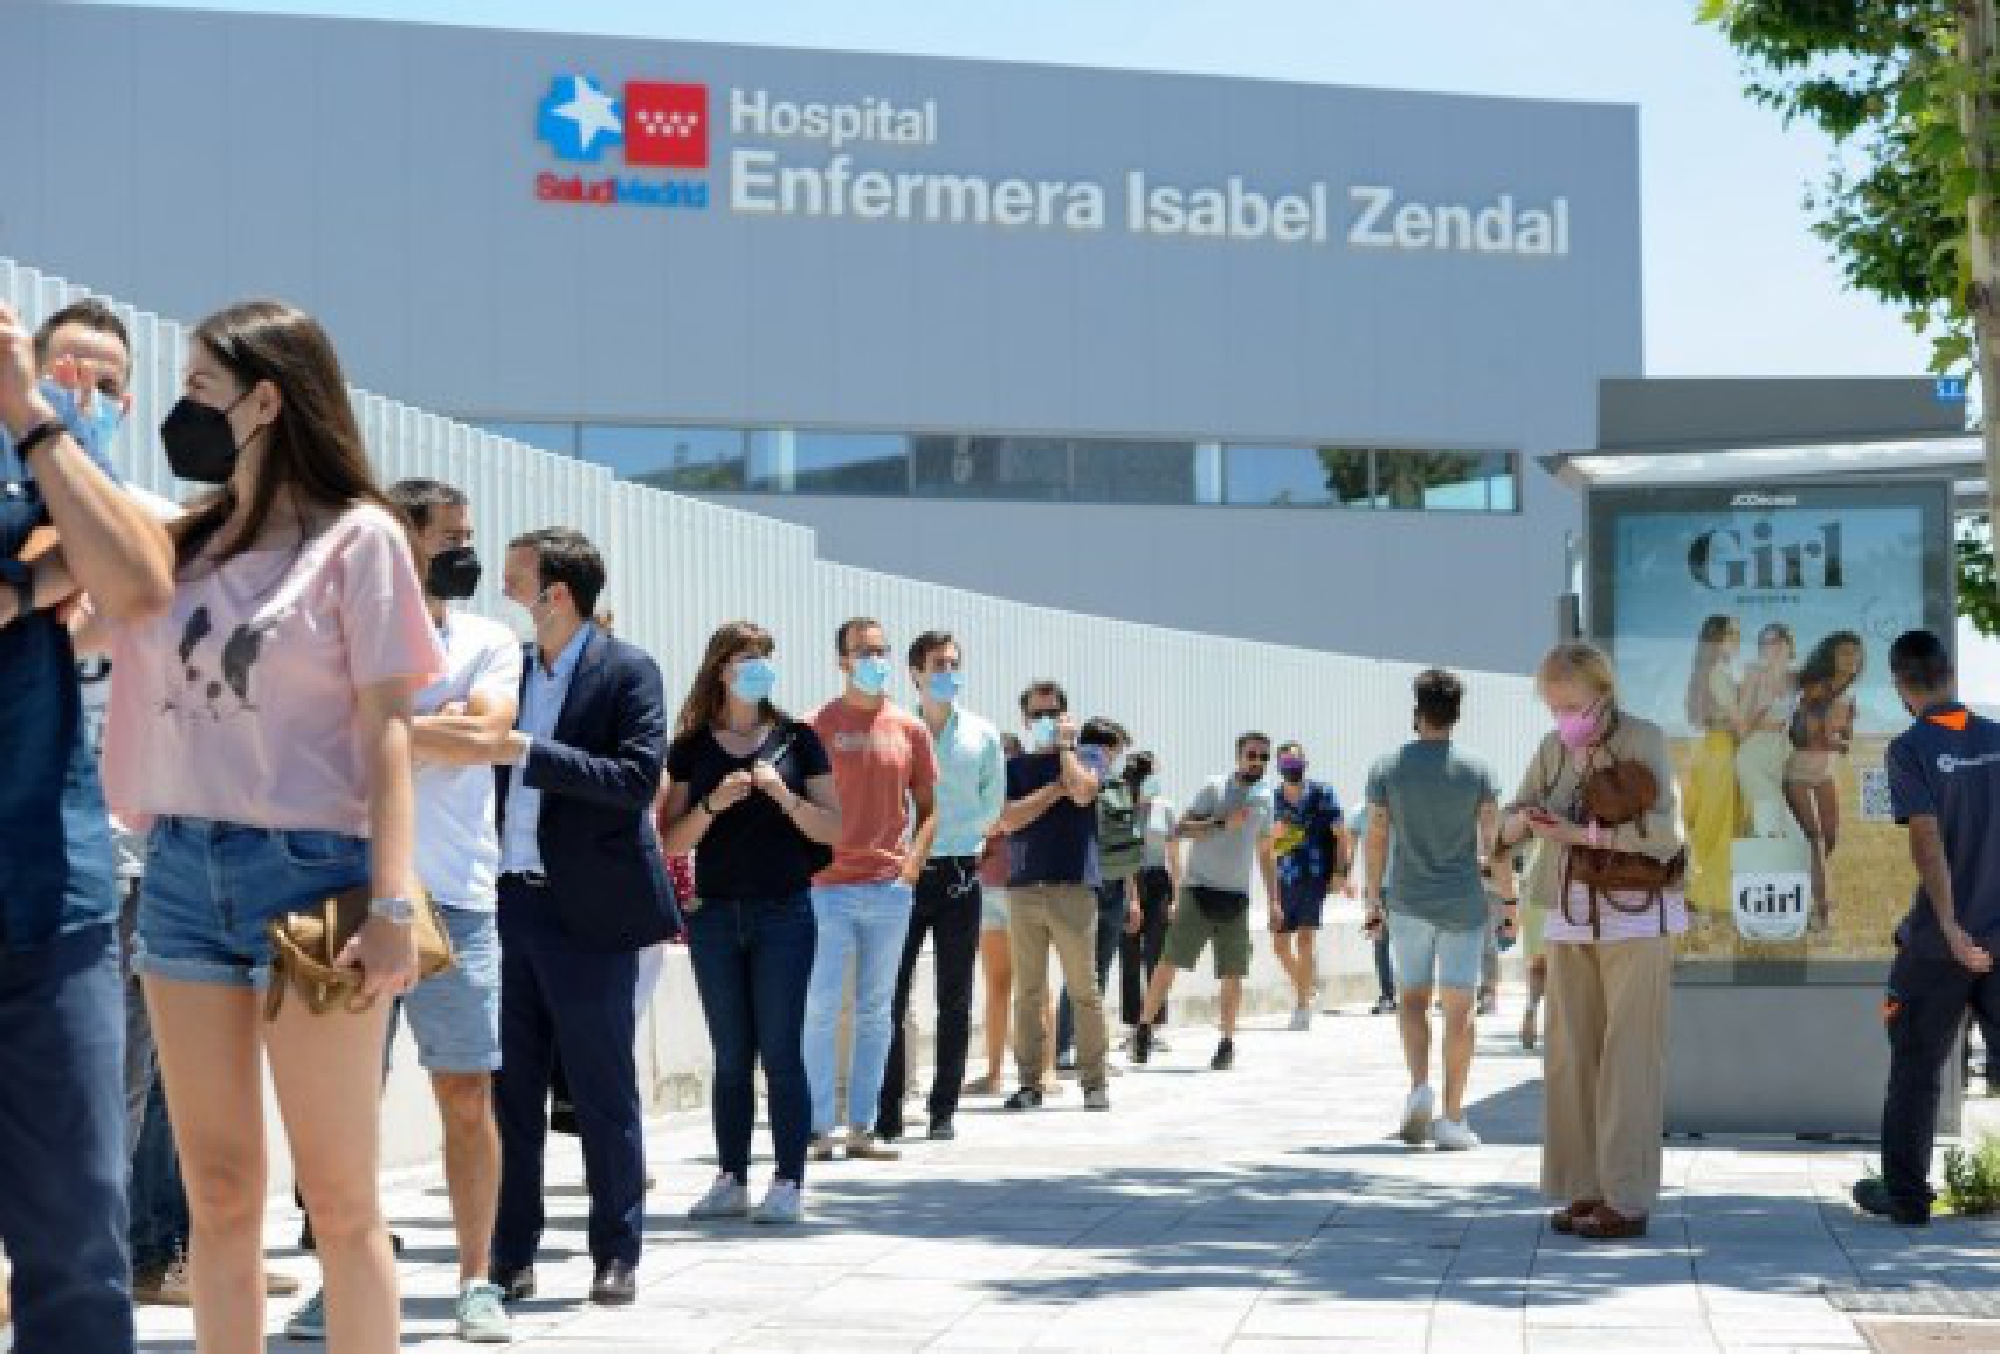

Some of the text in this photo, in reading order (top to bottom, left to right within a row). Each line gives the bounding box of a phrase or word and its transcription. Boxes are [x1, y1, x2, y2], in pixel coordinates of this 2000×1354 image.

[729, 86, 938, 146] Hospital
[729, 148, 1569, 254] Enfermera Isabel Zendal
[1687, 521, 1843, 590] Girl
[1739, 883, 1801, 913] Girl
